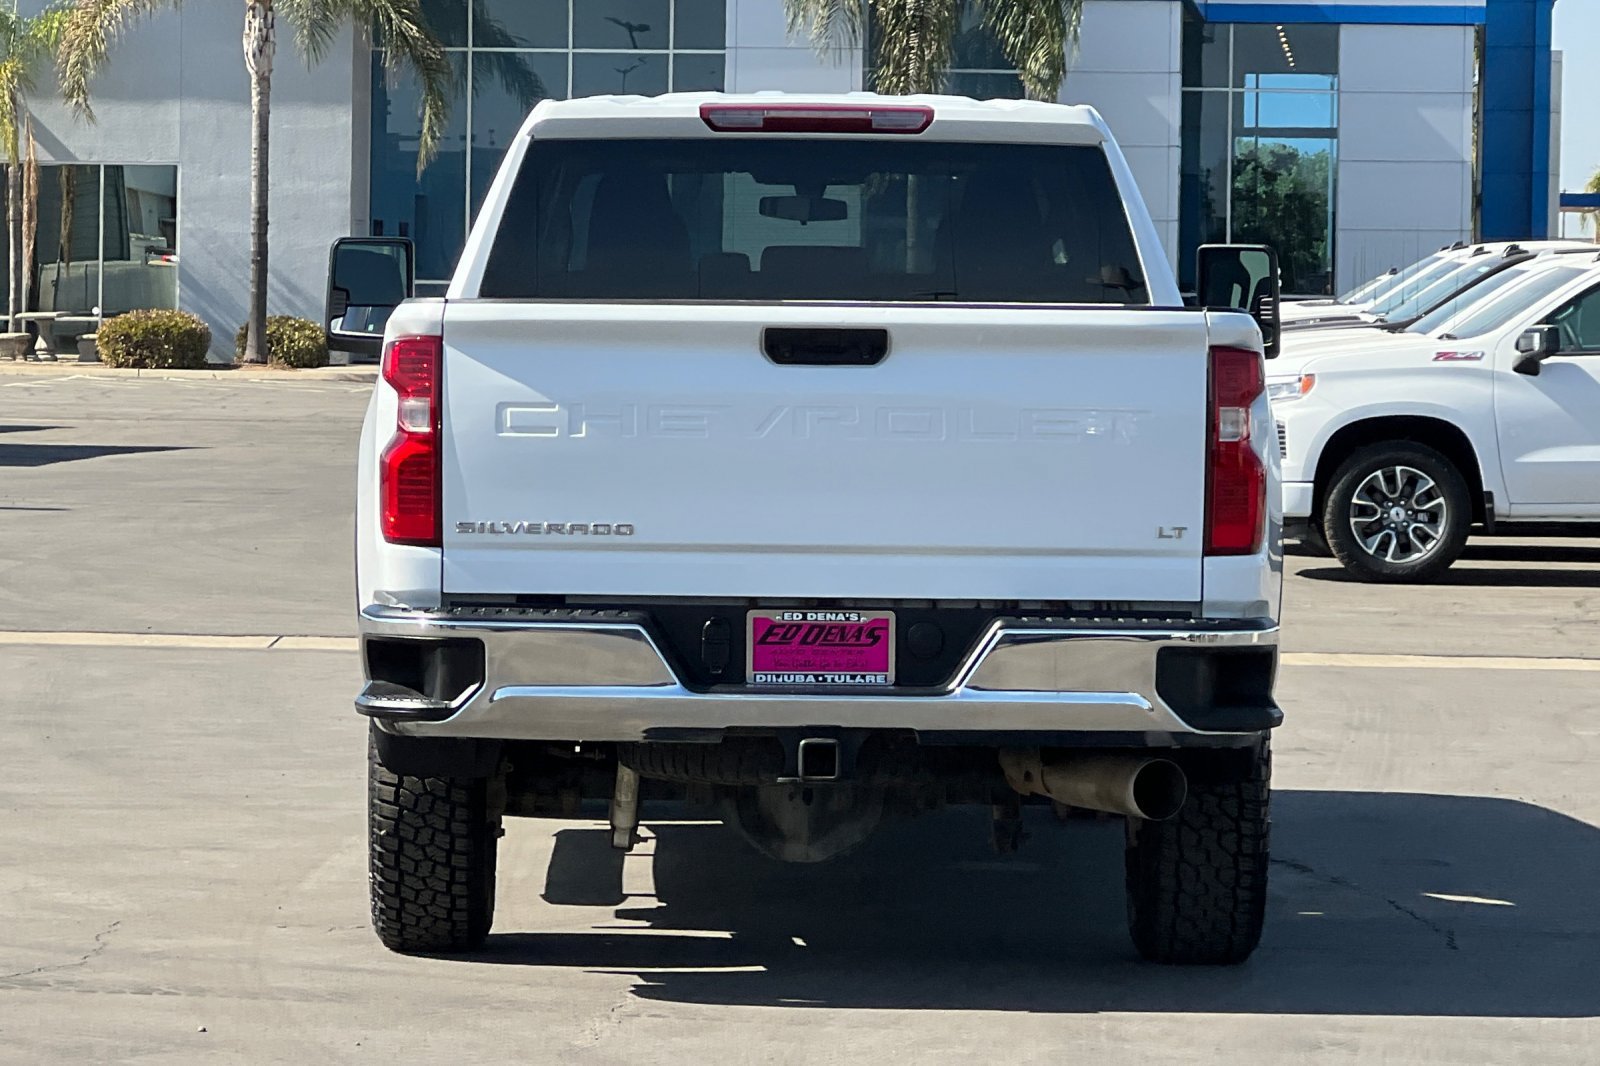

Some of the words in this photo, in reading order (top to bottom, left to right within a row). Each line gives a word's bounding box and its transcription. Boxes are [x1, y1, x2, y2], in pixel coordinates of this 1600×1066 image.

[455, 520, 635, 536] SILVERADO
[1157, 526, 1188, 540] LT
[783, 612, 802, 621] ED
[807, 612, 859, 621] DENA'S
[757, 624, 802, 645] ED
[755, 674, 816, 683] DINUBA
[824, 674, 886, 684] TULARE
